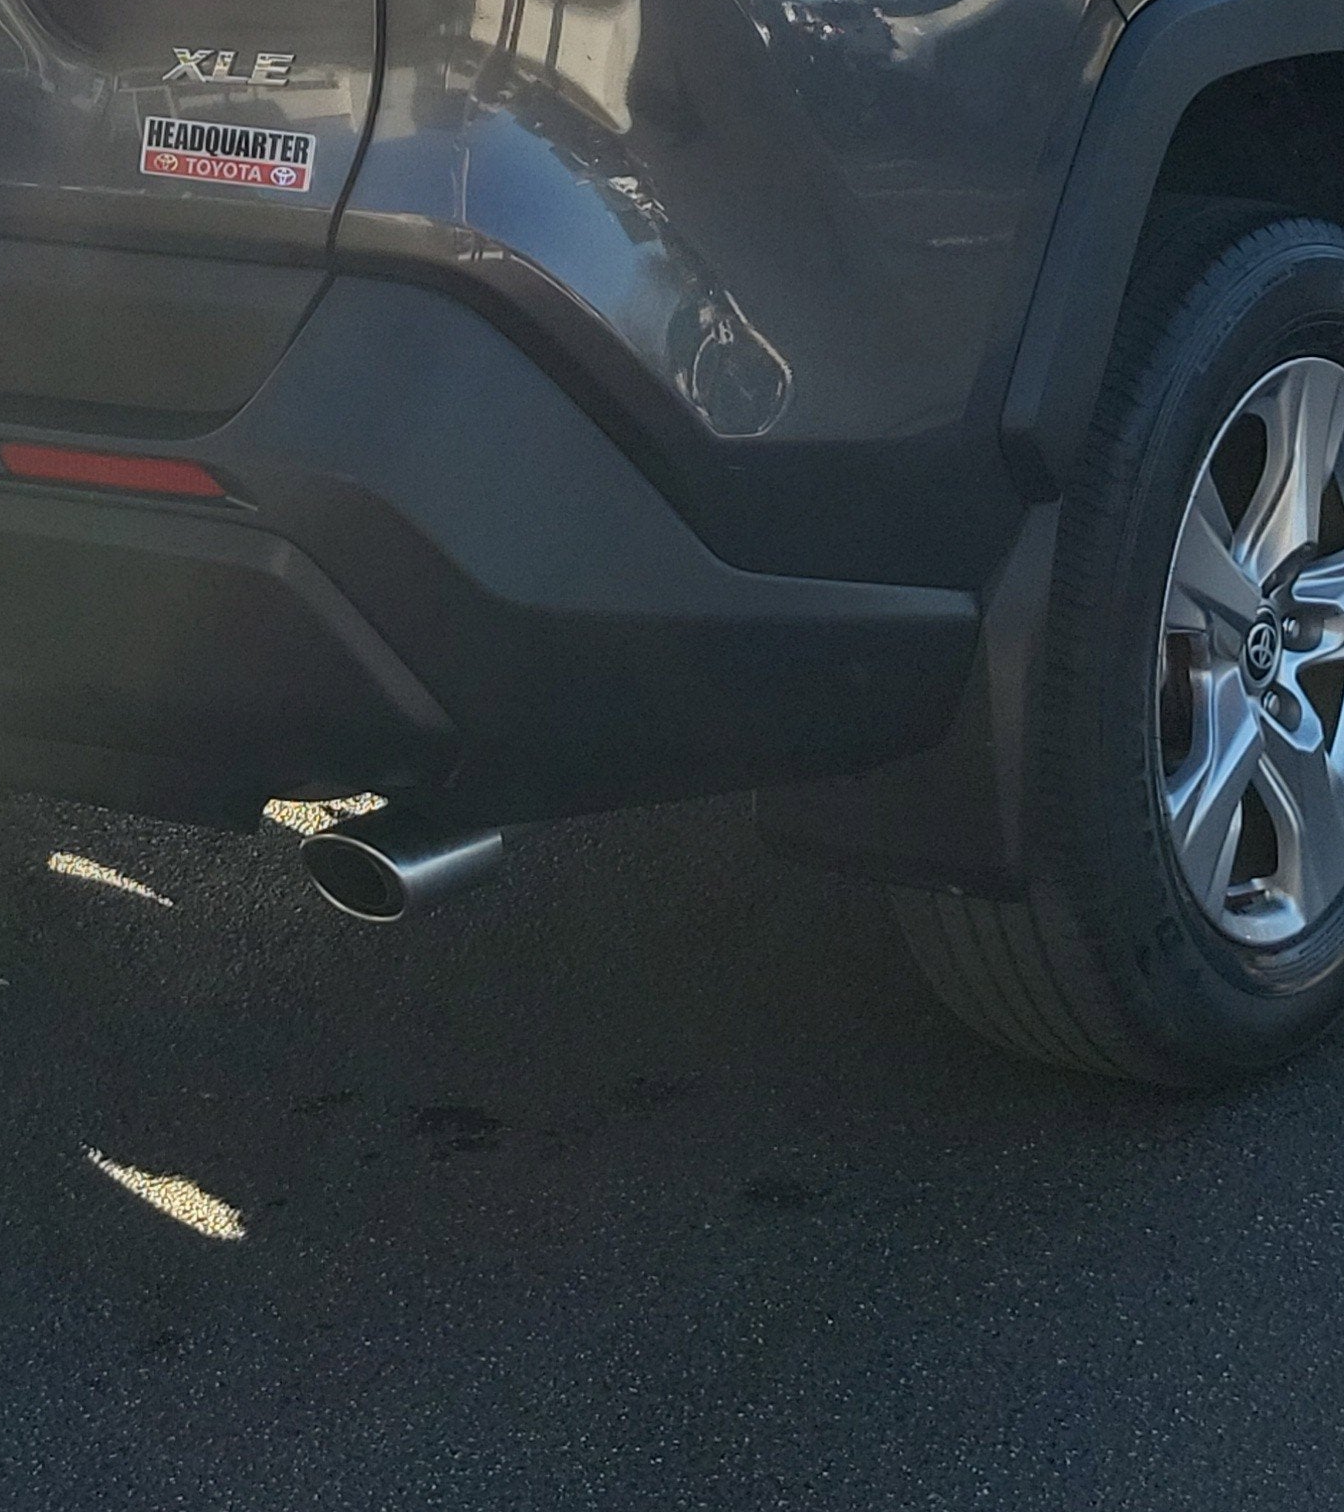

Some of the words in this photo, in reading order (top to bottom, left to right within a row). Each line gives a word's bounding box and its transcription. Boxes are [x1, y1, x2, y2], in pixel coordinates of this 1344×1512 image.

[162, 47, 296, 87] XLE
[146, 119, 310, 165] HEADQUARTER
[186, 157, 263, 183] TOYOTA
